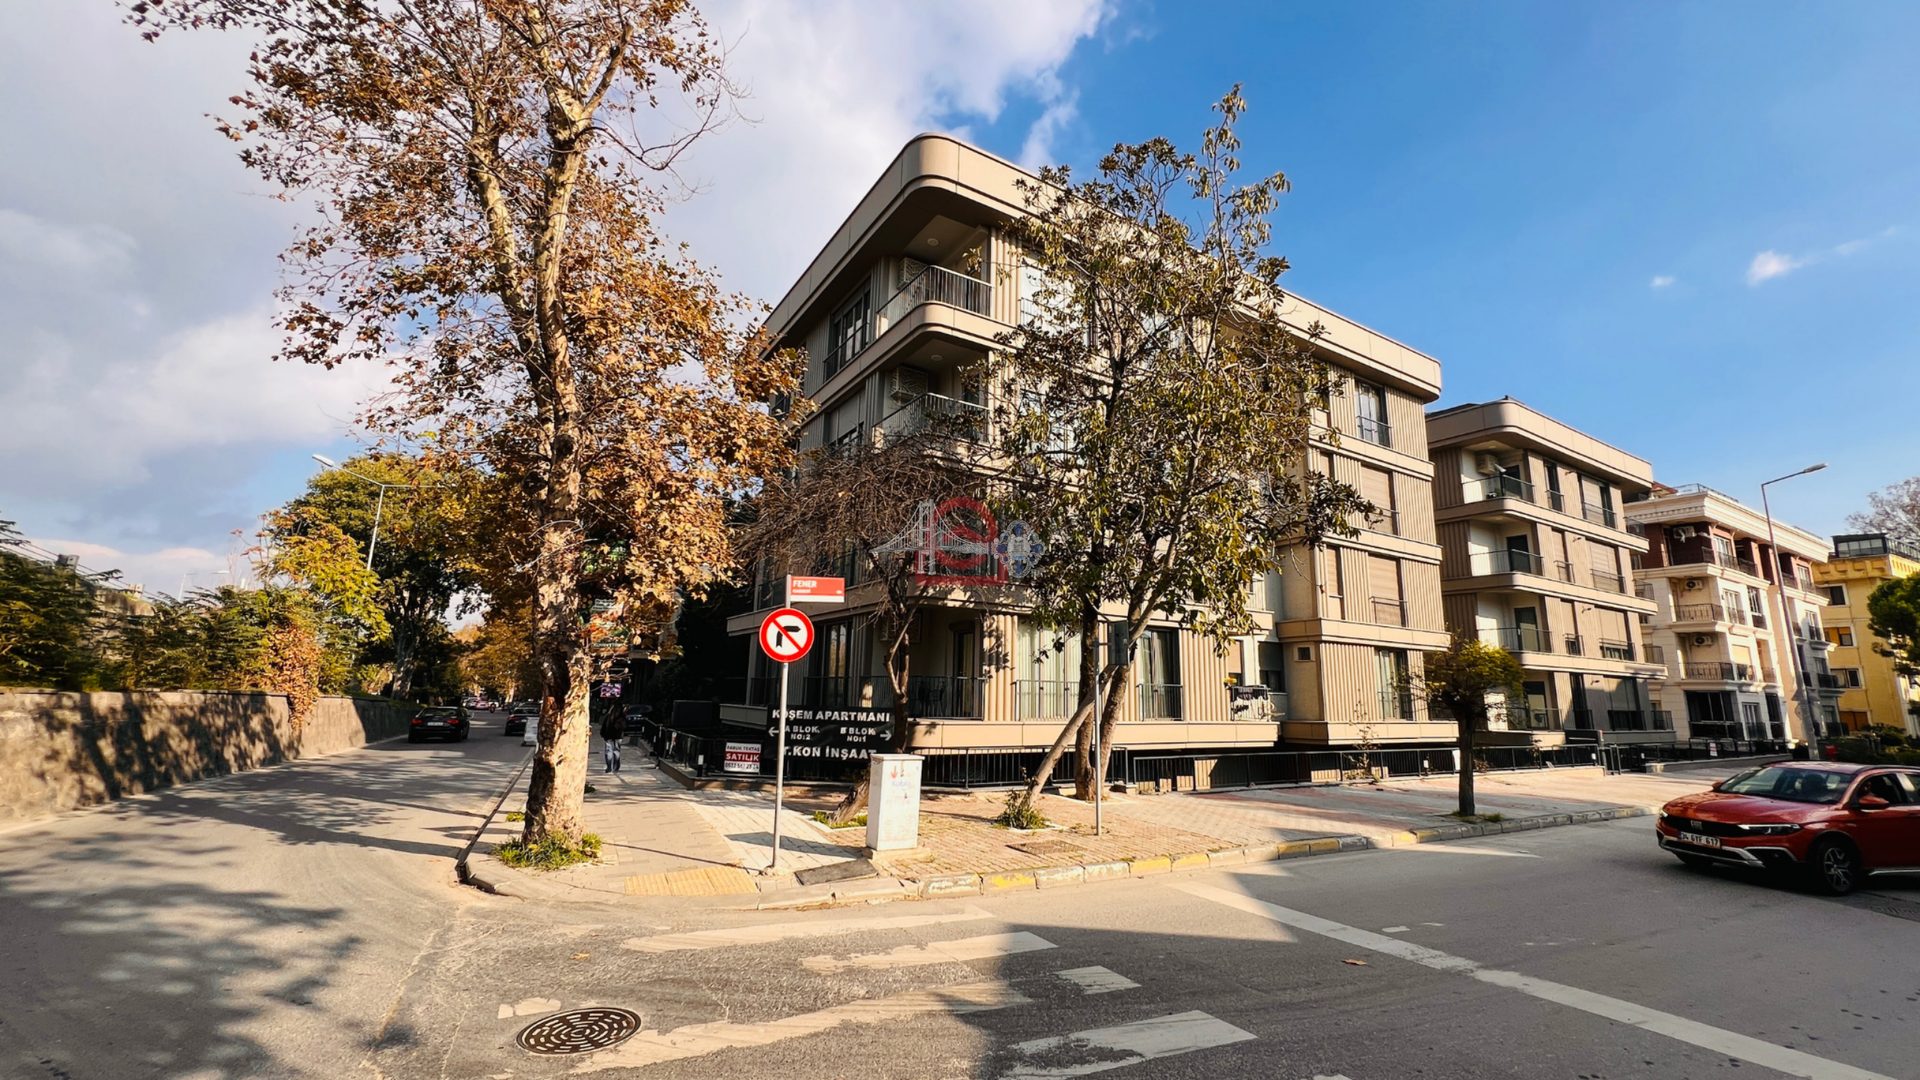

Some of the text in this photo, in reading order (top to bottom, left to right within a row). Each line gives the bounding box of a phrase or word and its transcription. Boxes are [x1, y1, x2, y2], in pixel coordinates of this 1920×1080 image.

[793, 580, 817, 588] FENER
[815, 711, 890, 722] APARTMANI
[785, 725, 791, 733] A
[790, 733, 811, 741] NO:2
[846, 735, 867, 743] NO:1
[825, 745, 877, 760] İNŞAAT
[726, 753, 759, 762] SATILIK
